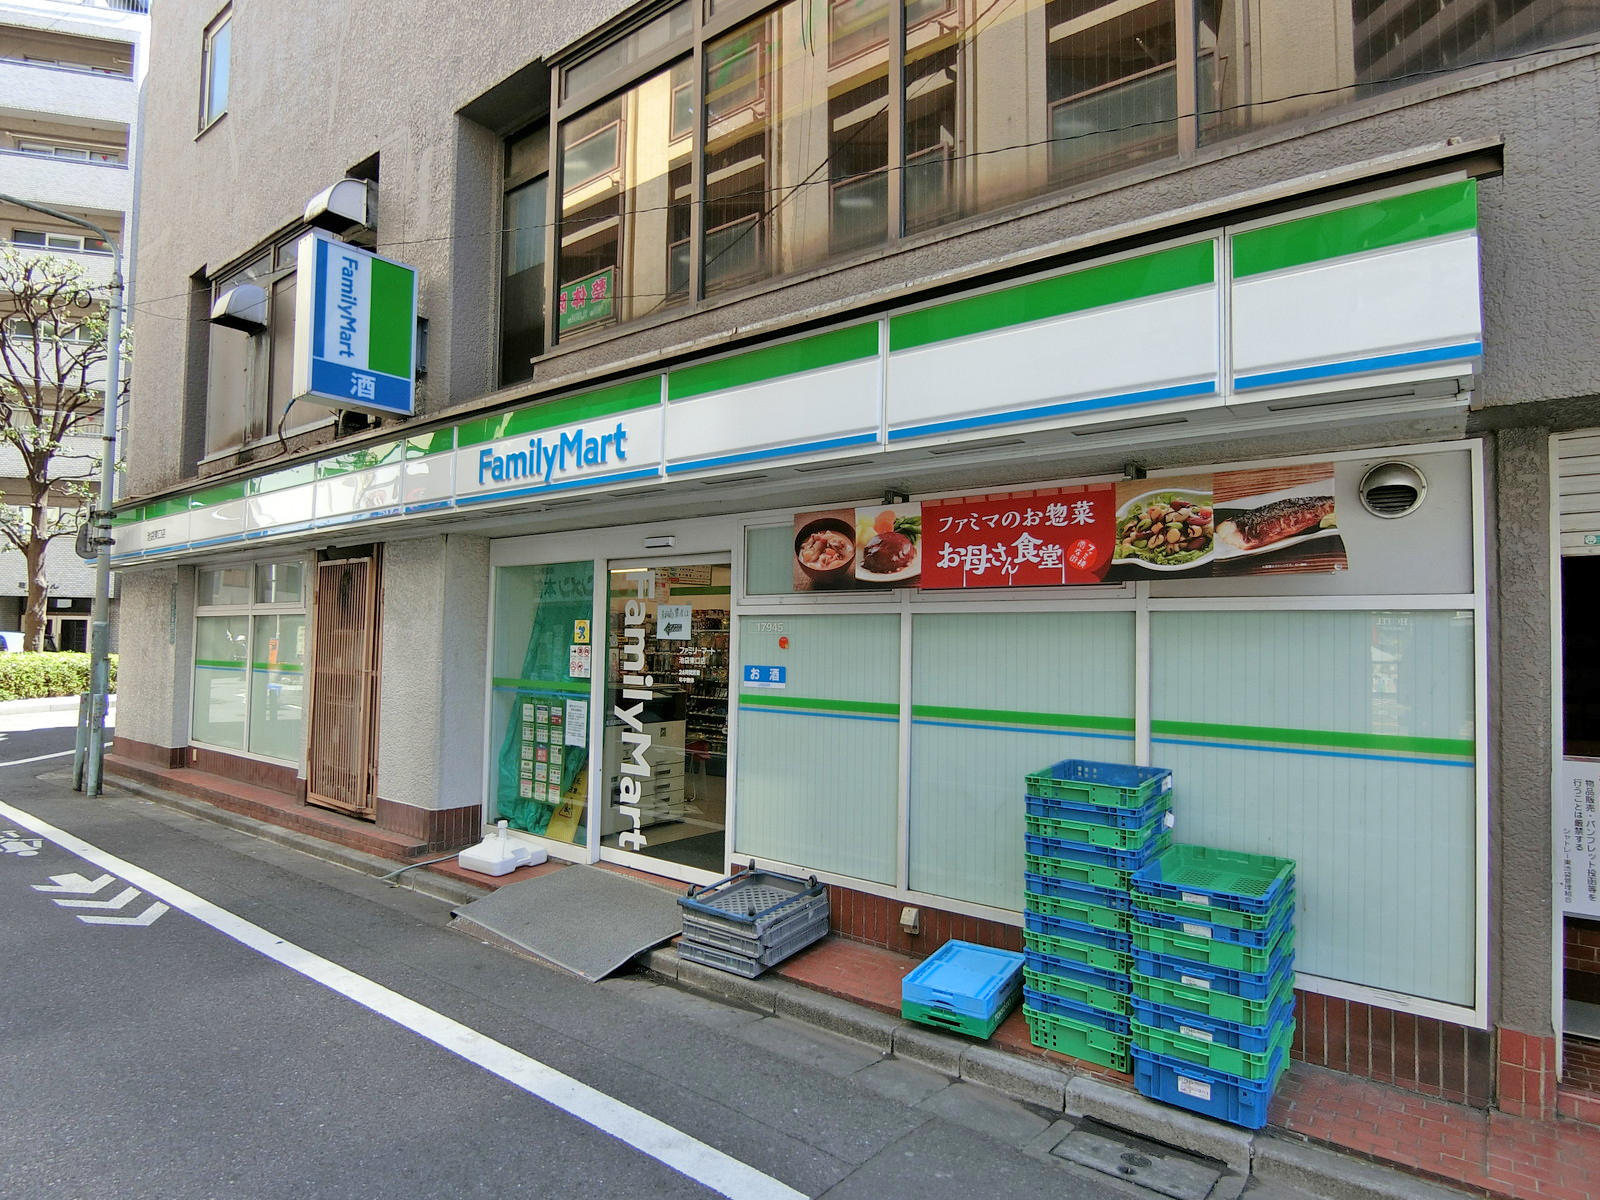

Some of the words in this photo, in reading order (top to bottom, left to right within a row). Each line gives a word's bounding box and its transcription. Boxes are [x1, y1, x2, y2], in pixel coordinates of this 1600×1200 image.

[337, 256, 358, 358] FamilyMart
[351, 371, 376, 400] 酒
[479, 422, 628, 484] FamilyMart
[938, 500, 1095, 534] ファミマのお惣菜
[936, 532, 1063, 575] お母さん食堂
[757, 623, 784, 632] 17945
[679, 646, 716, 655] ファミリーマート
[750, 667, 780, 681] お酒
[614, 570, 656, 851] FamilyMart
